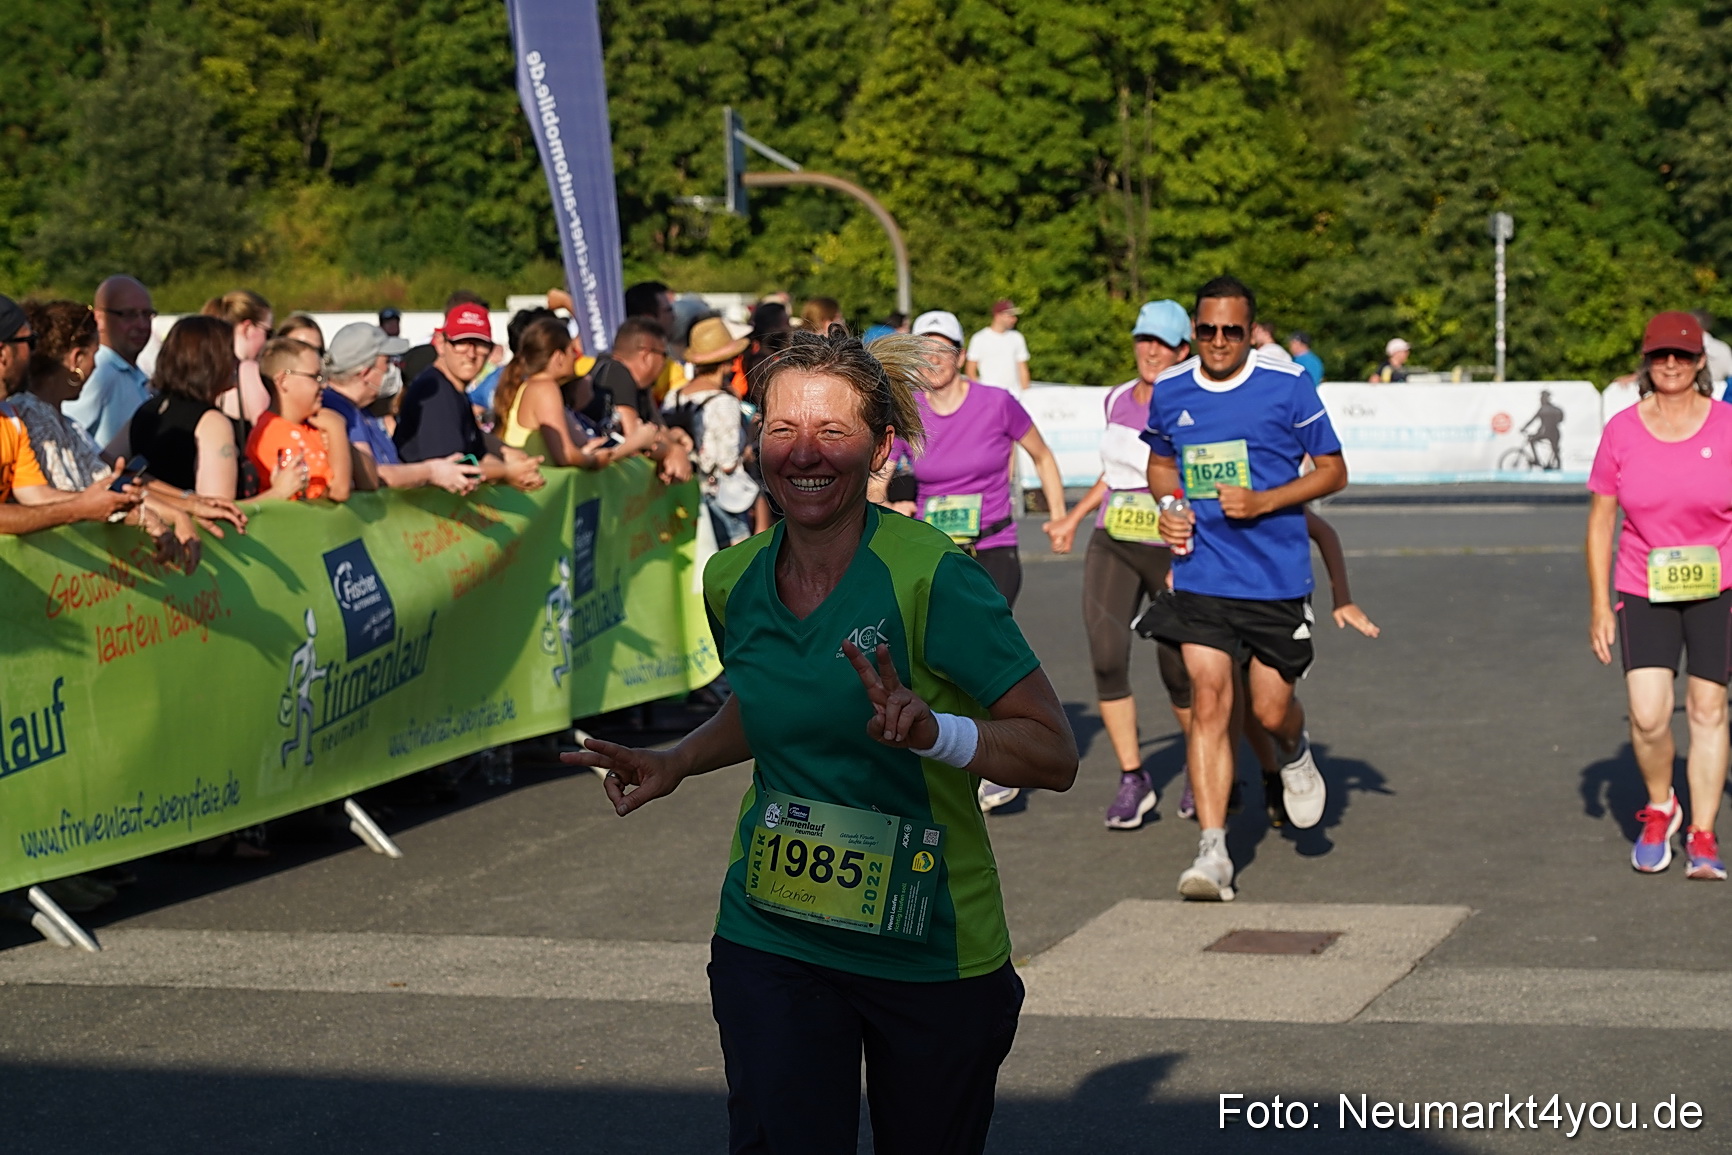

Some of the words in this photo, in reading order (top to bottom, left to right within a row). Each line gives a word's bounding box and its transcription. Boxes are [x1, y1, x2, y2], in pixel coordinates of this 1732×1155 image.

[1192, 461, 1237, 481] 1628
[1116, 507, 1156, 527] 1289
[45, 546, 137, 619] Gesunde
[1667, 564, 1704, 583] 899
[96, 603, 163, 665] laufen
[838, 618, 889, 651] AOK
[322, 610, 438, 728] firmenlauf
[20, 769, 241, 859] www.firmenlauf-oberpfalz.de
[780, 817, 826, 832] Firmenlauf
[795, 829, 823, 837] neumarkt
[902, 832, 910, 848] AOK
[750, 833, 766, 889] WALK
[767, 834, 865, 889] 1985
[769, 880, 817, 904] Marion
[861, 861, 883, 915] 2022
[890, 894, 898, 912] Laufen
[897, 894, 905, 912] laufen
[887, 912, 895, 931] Wenn
[894, 913, 903, 933] richtig
